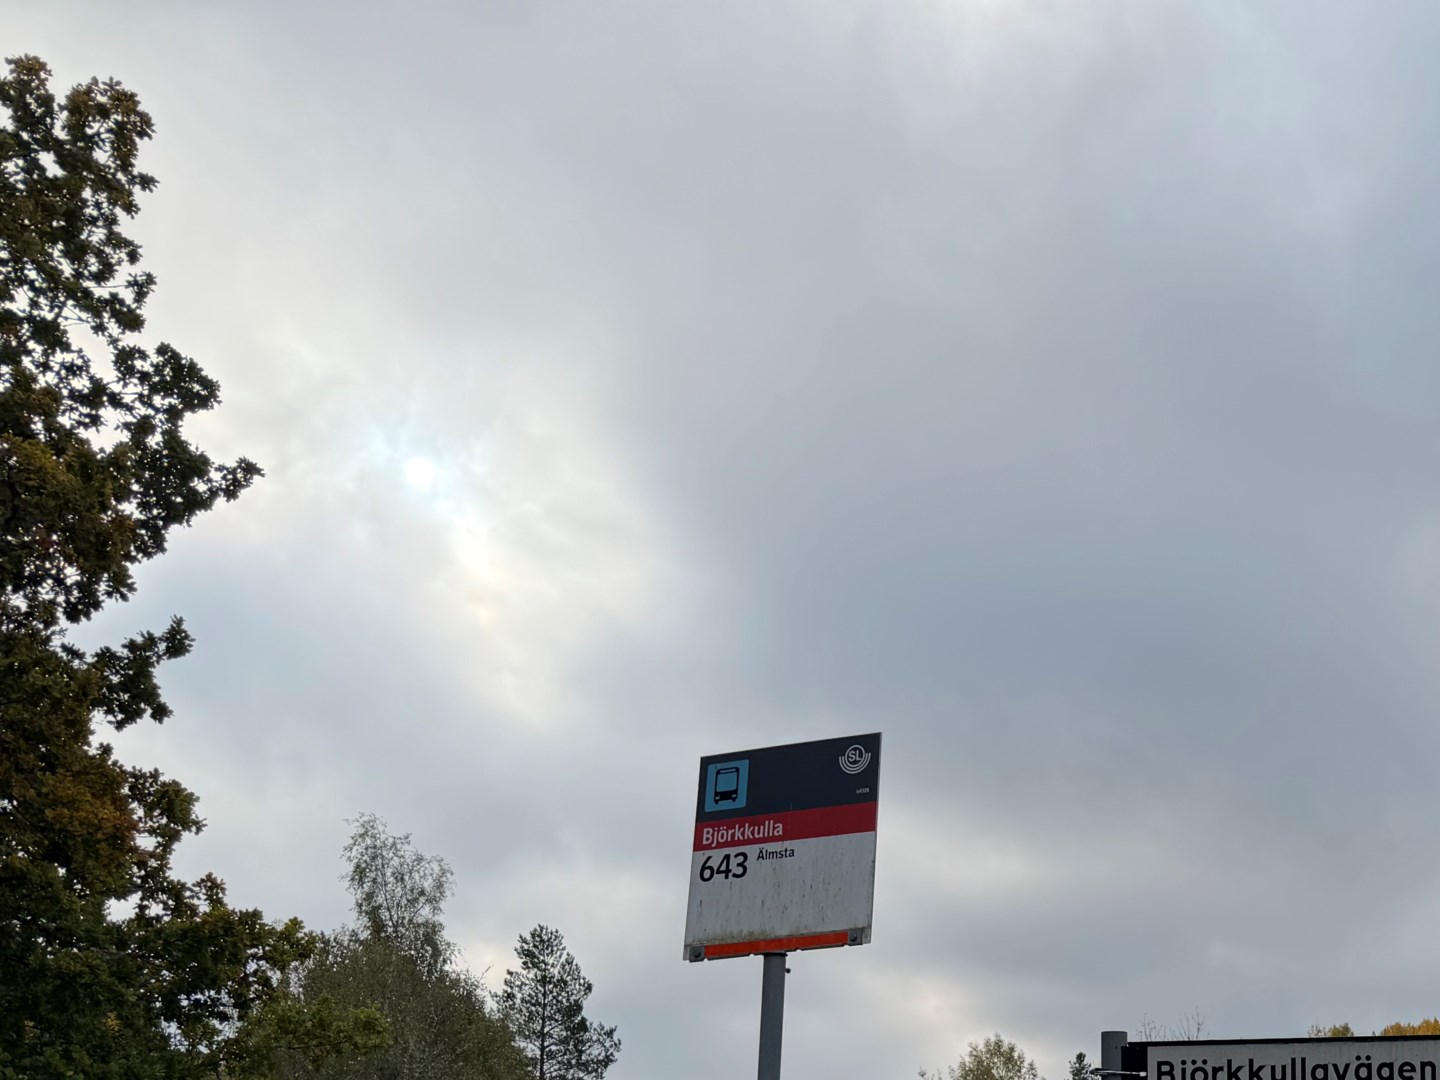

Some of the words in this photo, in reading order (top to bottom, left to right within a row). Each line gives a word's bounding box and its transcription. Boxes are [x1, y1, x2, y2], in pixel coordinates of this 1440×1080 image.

[848, 750, 862, 762] SL
[702, 820, 783, 848] Björkkulla
[757, 847, 795, 861] Älmsta
[699, 851, 748, 882] 643
